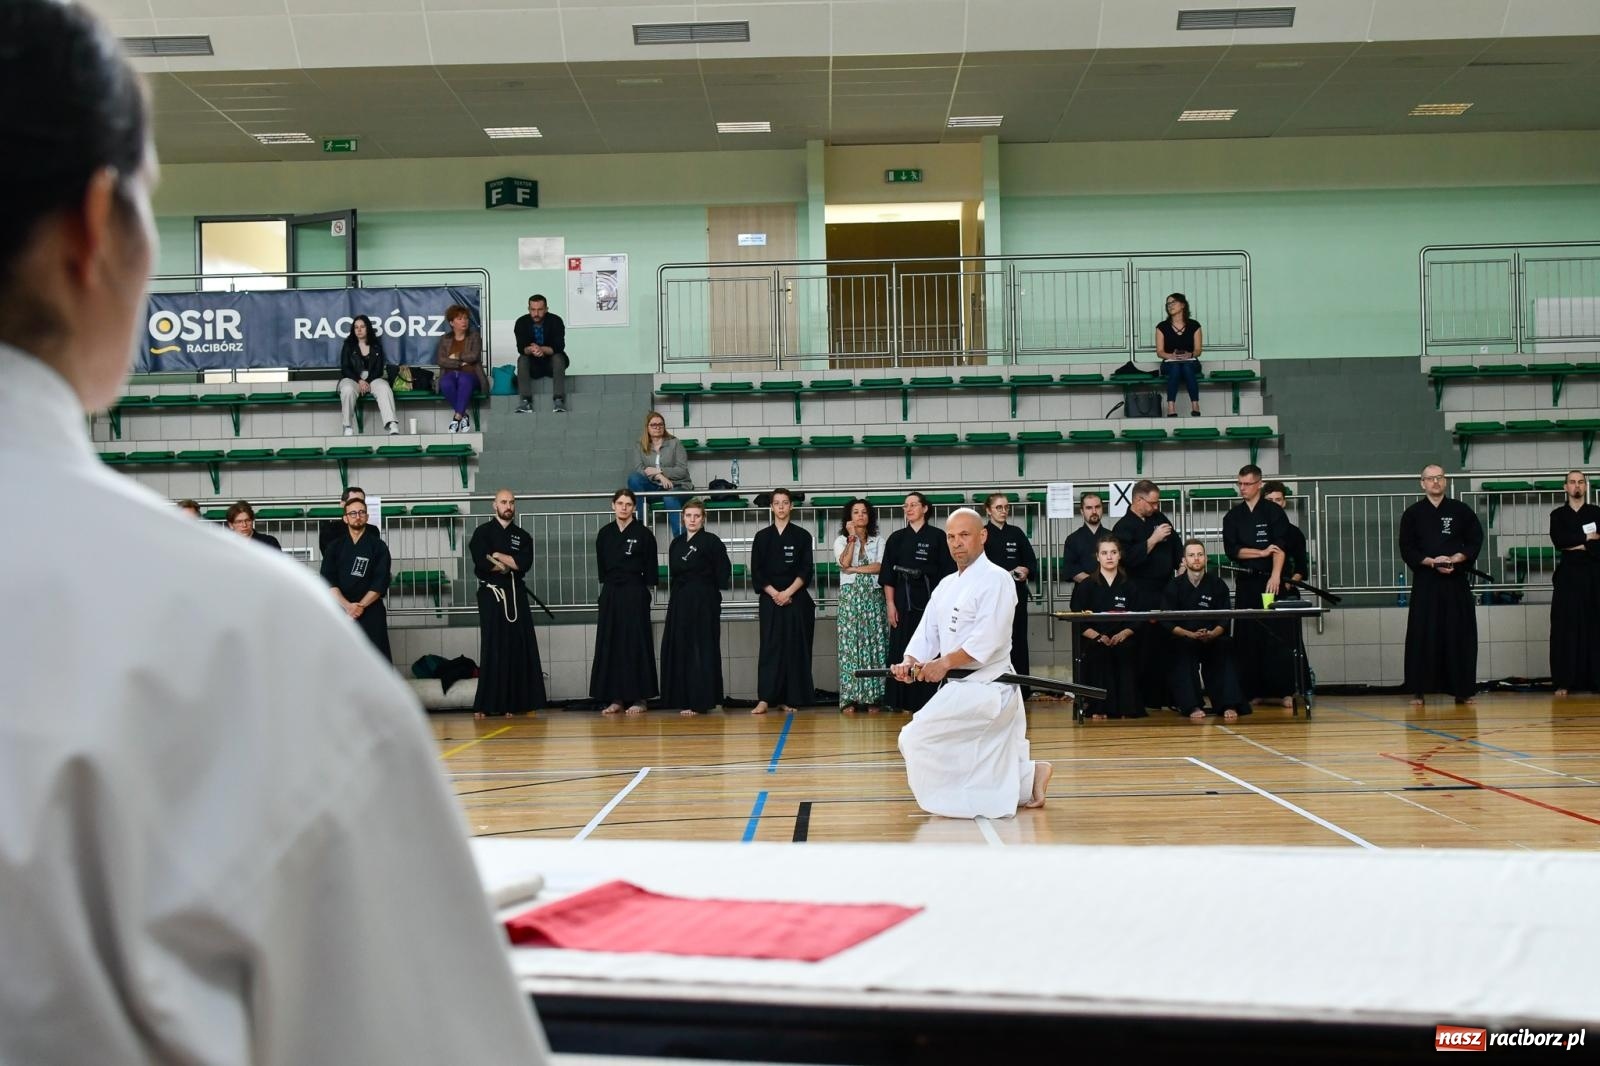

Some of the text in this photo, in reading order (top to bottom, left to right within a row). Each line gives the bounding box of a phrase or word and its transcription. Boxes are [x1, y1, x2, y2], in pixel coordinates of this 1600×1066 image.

[491, 188, 502, 205] F
[517, 187, 530, 203] F
[294, 308, 446, 339] RACBÓRZ
[187, 341, 243, 353] RACIBÓRZ
